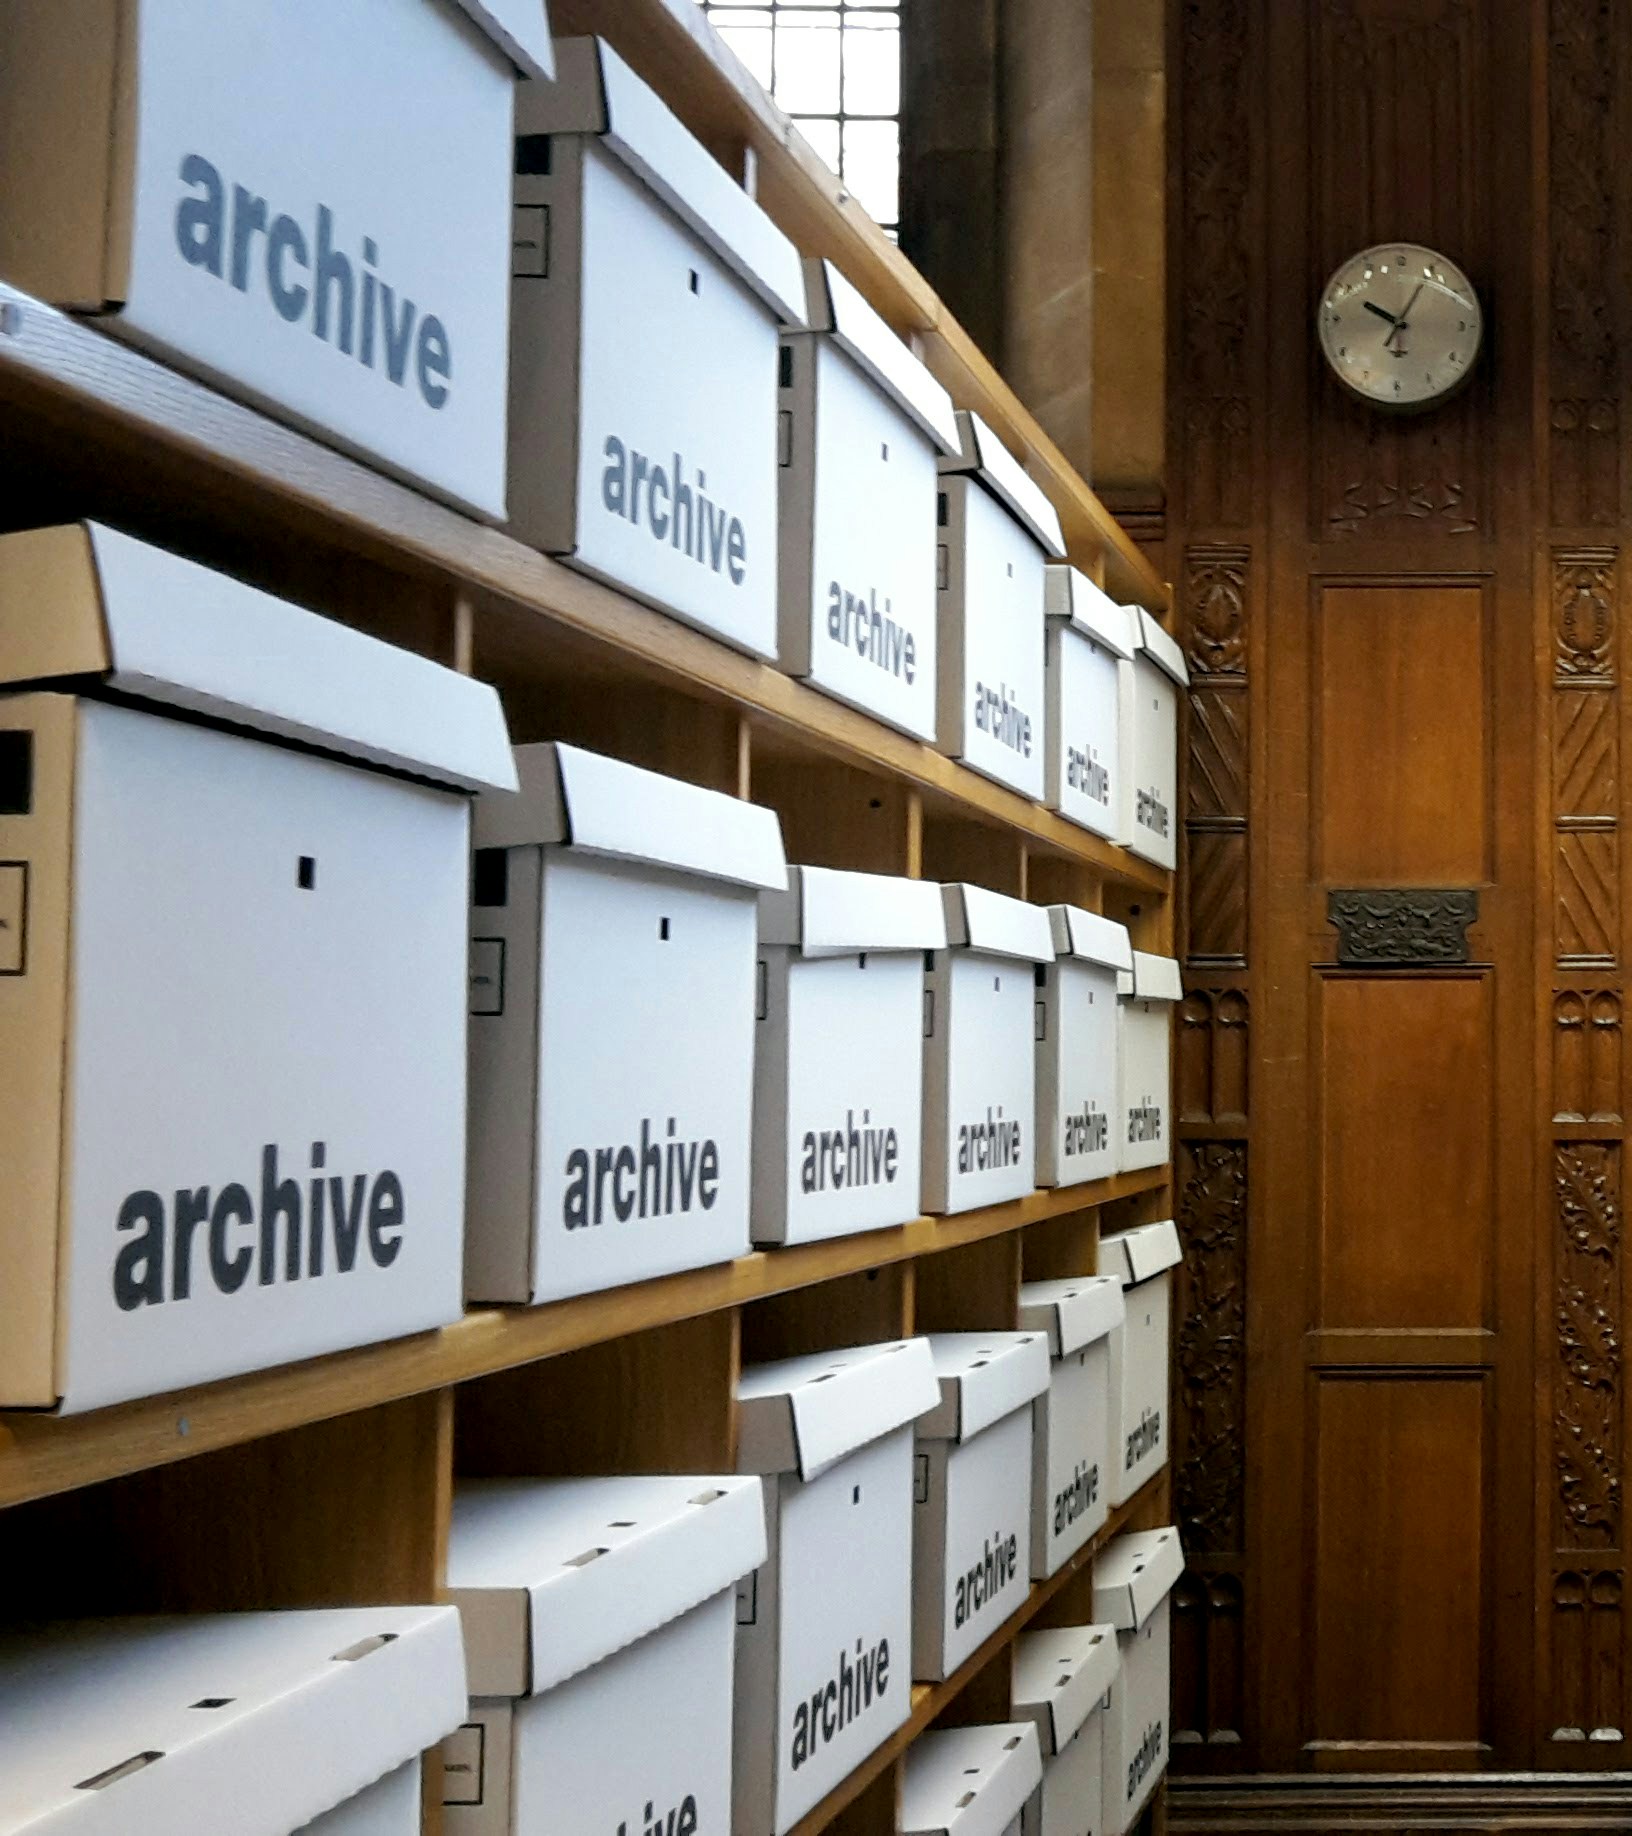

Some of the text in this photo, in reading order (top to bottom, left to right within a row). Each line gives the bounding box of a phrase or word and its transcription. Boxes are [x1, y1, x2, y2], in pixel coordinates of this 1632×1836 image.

[176, 154, 452, 409] archive
[603, 435, 746, 586] archive
[828, 580, 916, 684] archive
[975, 681, 1031, 758] archive
[1066, 745, 1110, 806] archive
[802, 1110, 897, 1194] archive
[958, 1107, 1020, 1174] archive
[1064, 1101, 1107, 1156] archive
[1128, 1095, 1160, 1143] archive
[563, 1118, 718, 1231] archive
[113, 1142, 404, 1311] archive
[1125, 1406, 1161, 1472] archive
[1054, 1460, 1100, 1537] archive
[954, 1532, 1018, 1630] archive
[791, 1638, 890, 1771] archive
[1127, 1720, 1162, 1801] archive
